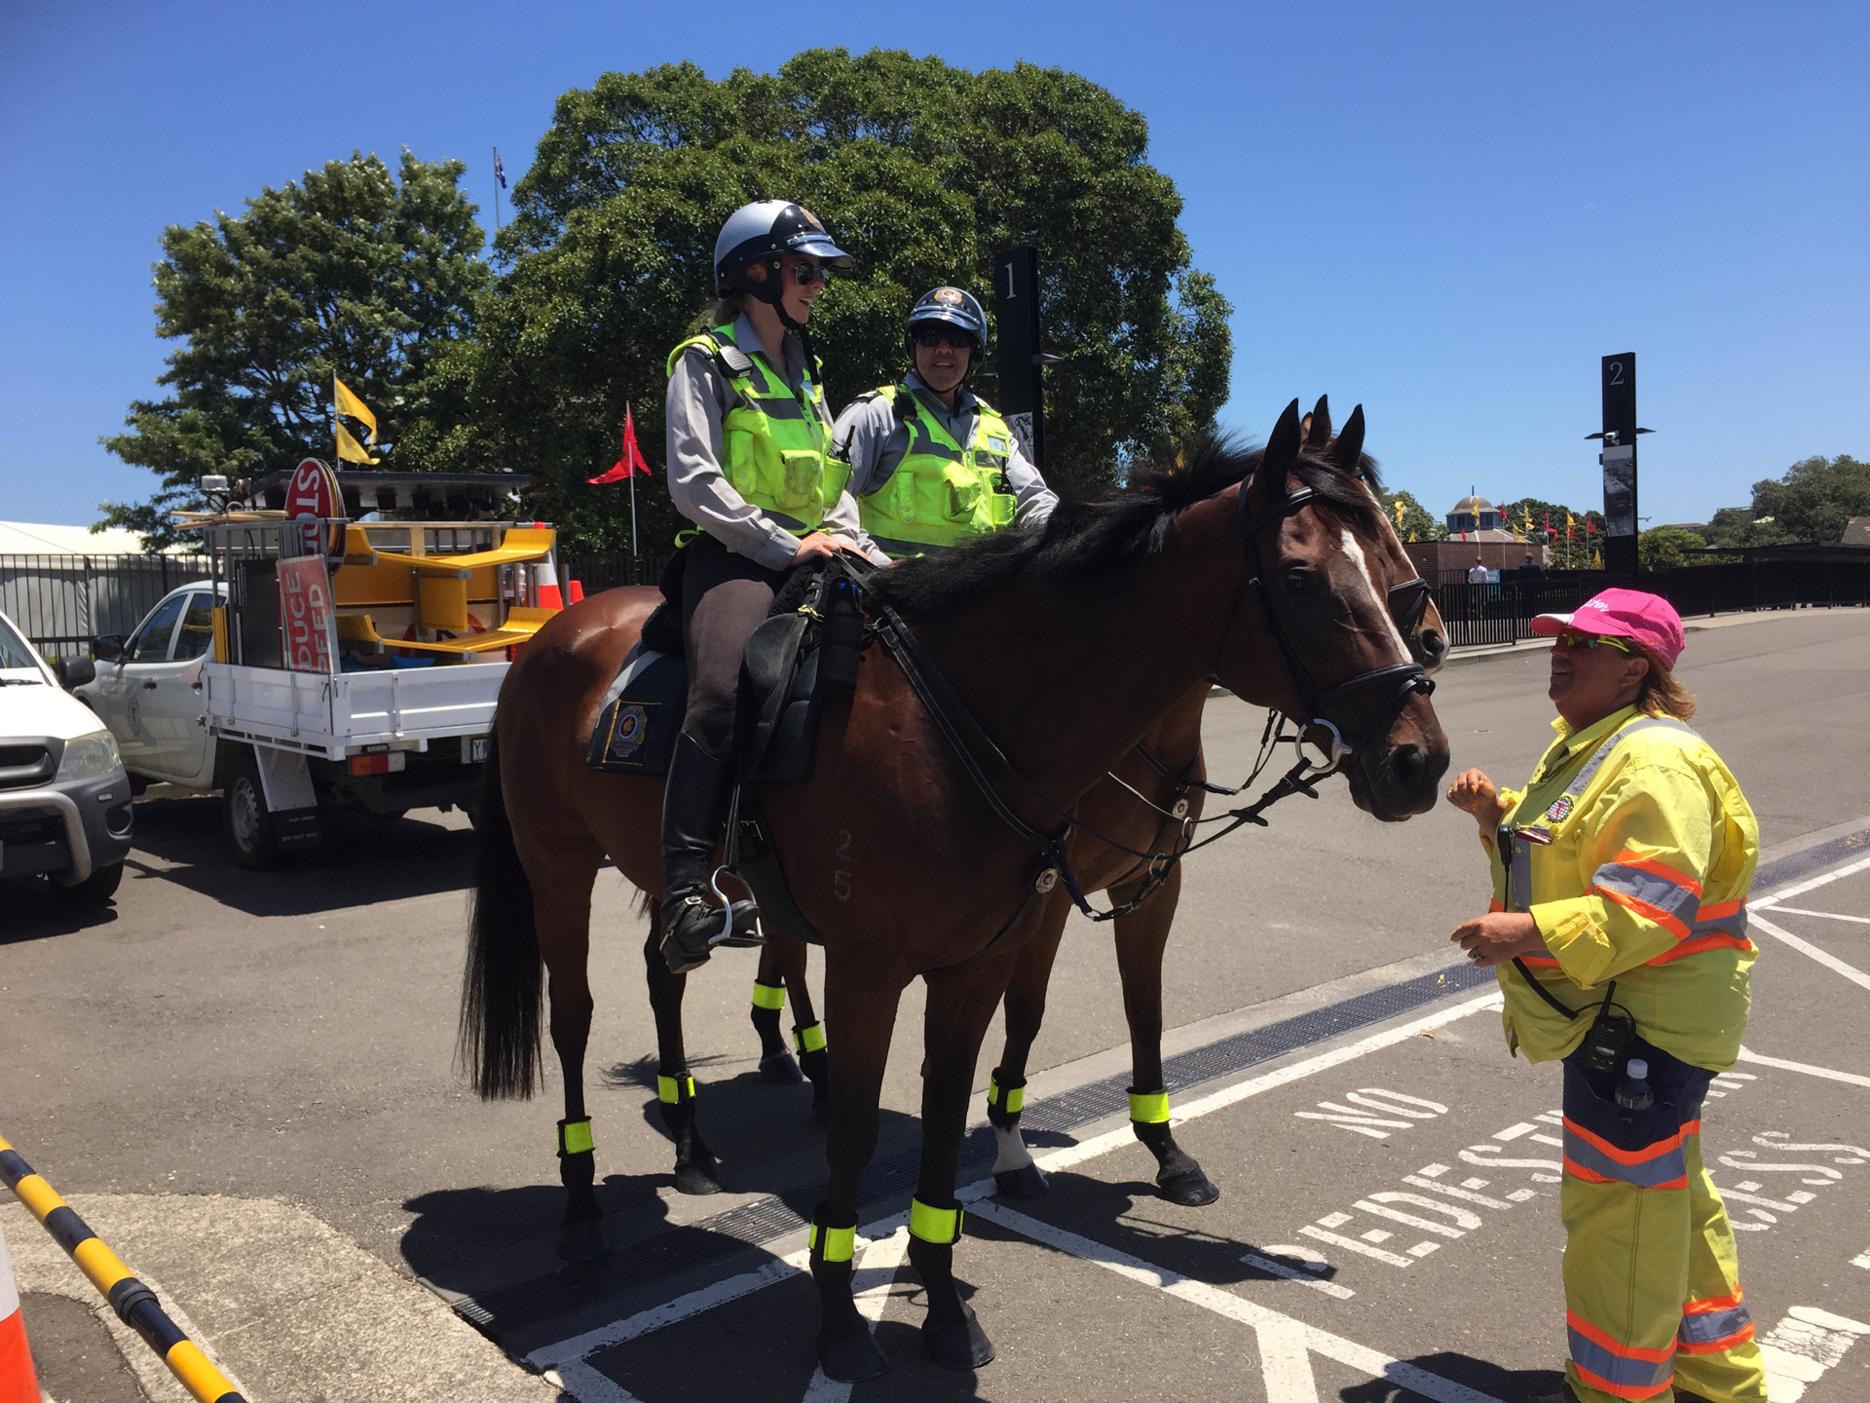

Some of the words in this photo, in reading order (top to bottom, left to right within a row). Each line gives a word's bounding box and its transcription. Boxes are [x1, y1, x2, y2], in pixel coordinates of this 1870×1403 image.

[1004, 262, 1017, 300] 1
[1609, 361, 1625, 386] 2
[284, 571, 313, 671] DUCE
[1294, 1087, 1449, 1139] NO
